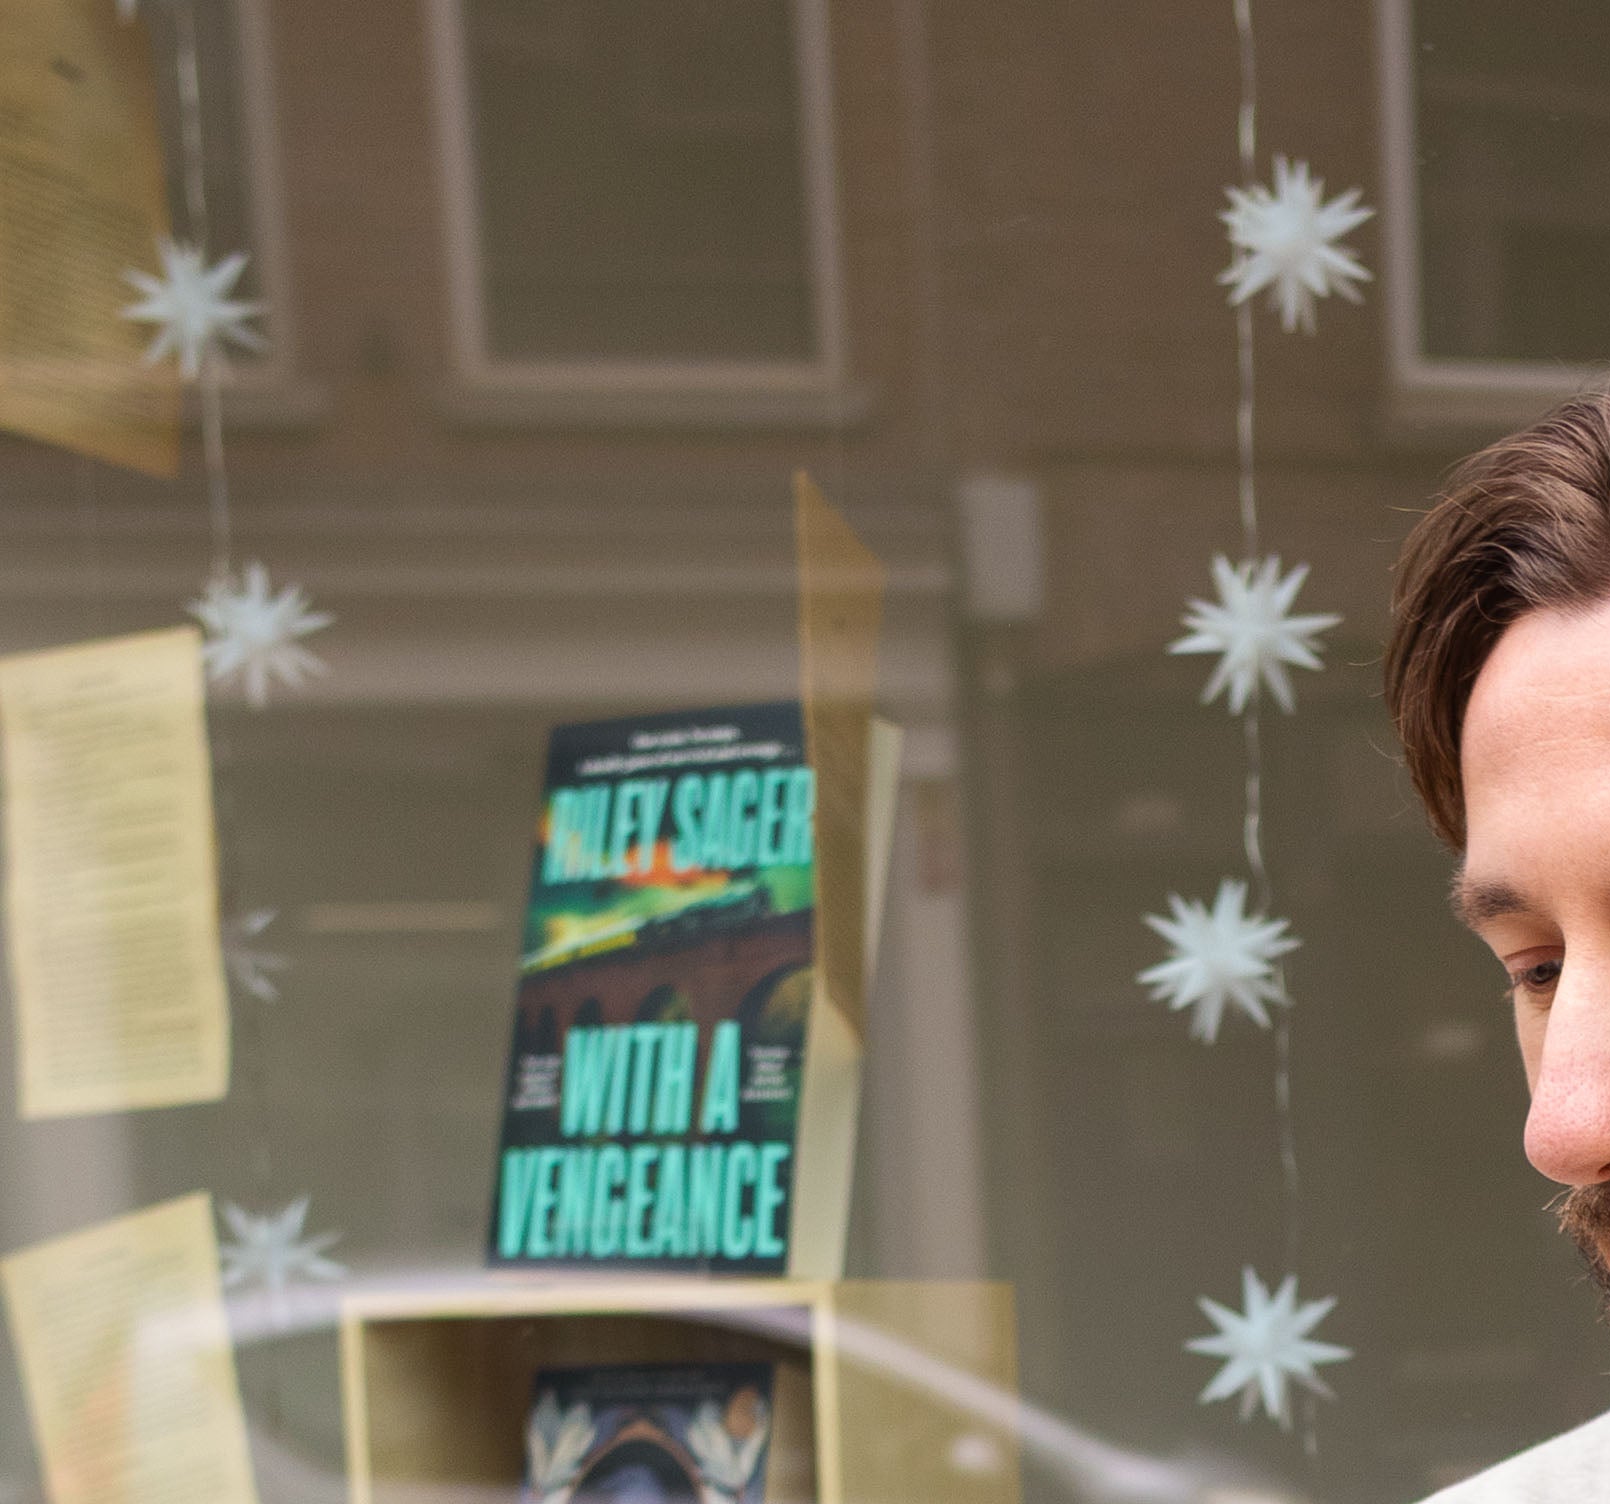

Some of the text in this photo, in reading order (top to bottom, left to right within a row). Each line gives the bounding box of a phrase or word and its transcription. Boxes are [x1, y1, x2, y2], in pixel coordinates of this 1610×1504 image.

[560, 1020, 698, 1138] WITH
[701, 1018, 741, 1135] A
[498, 1141, 791, 1260] VENGEANCE
